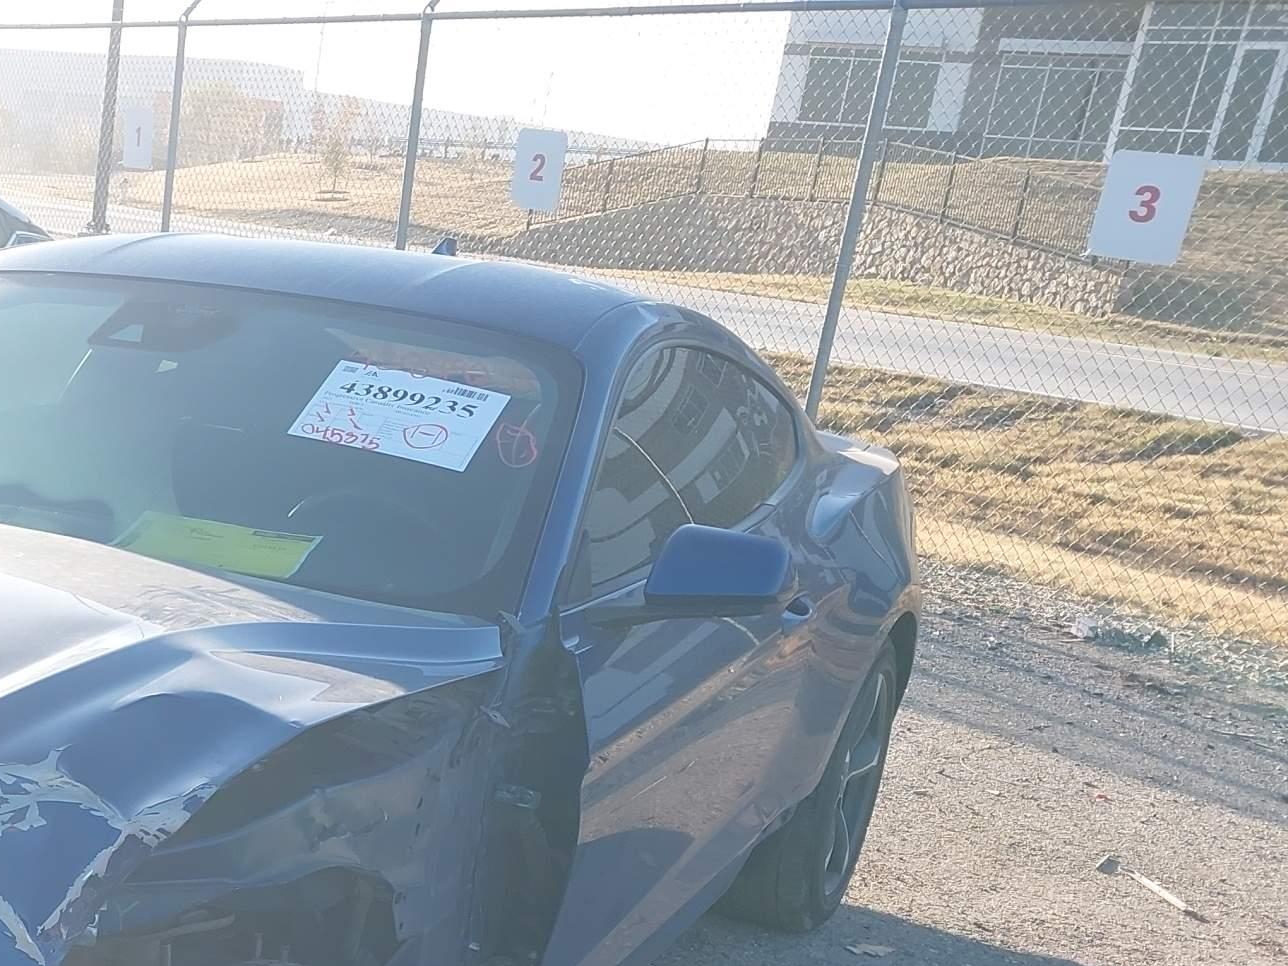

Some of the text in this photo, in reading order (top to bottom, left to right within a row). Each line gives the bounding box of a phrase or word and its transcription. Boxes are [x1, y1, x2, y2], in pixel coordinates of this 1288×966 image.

[134, 125, 142, 147] 1
[529, 153, 547, 182] 2
[1128, 184, 1162, 223] 3
[340, 379, 479, 420] 43899235
